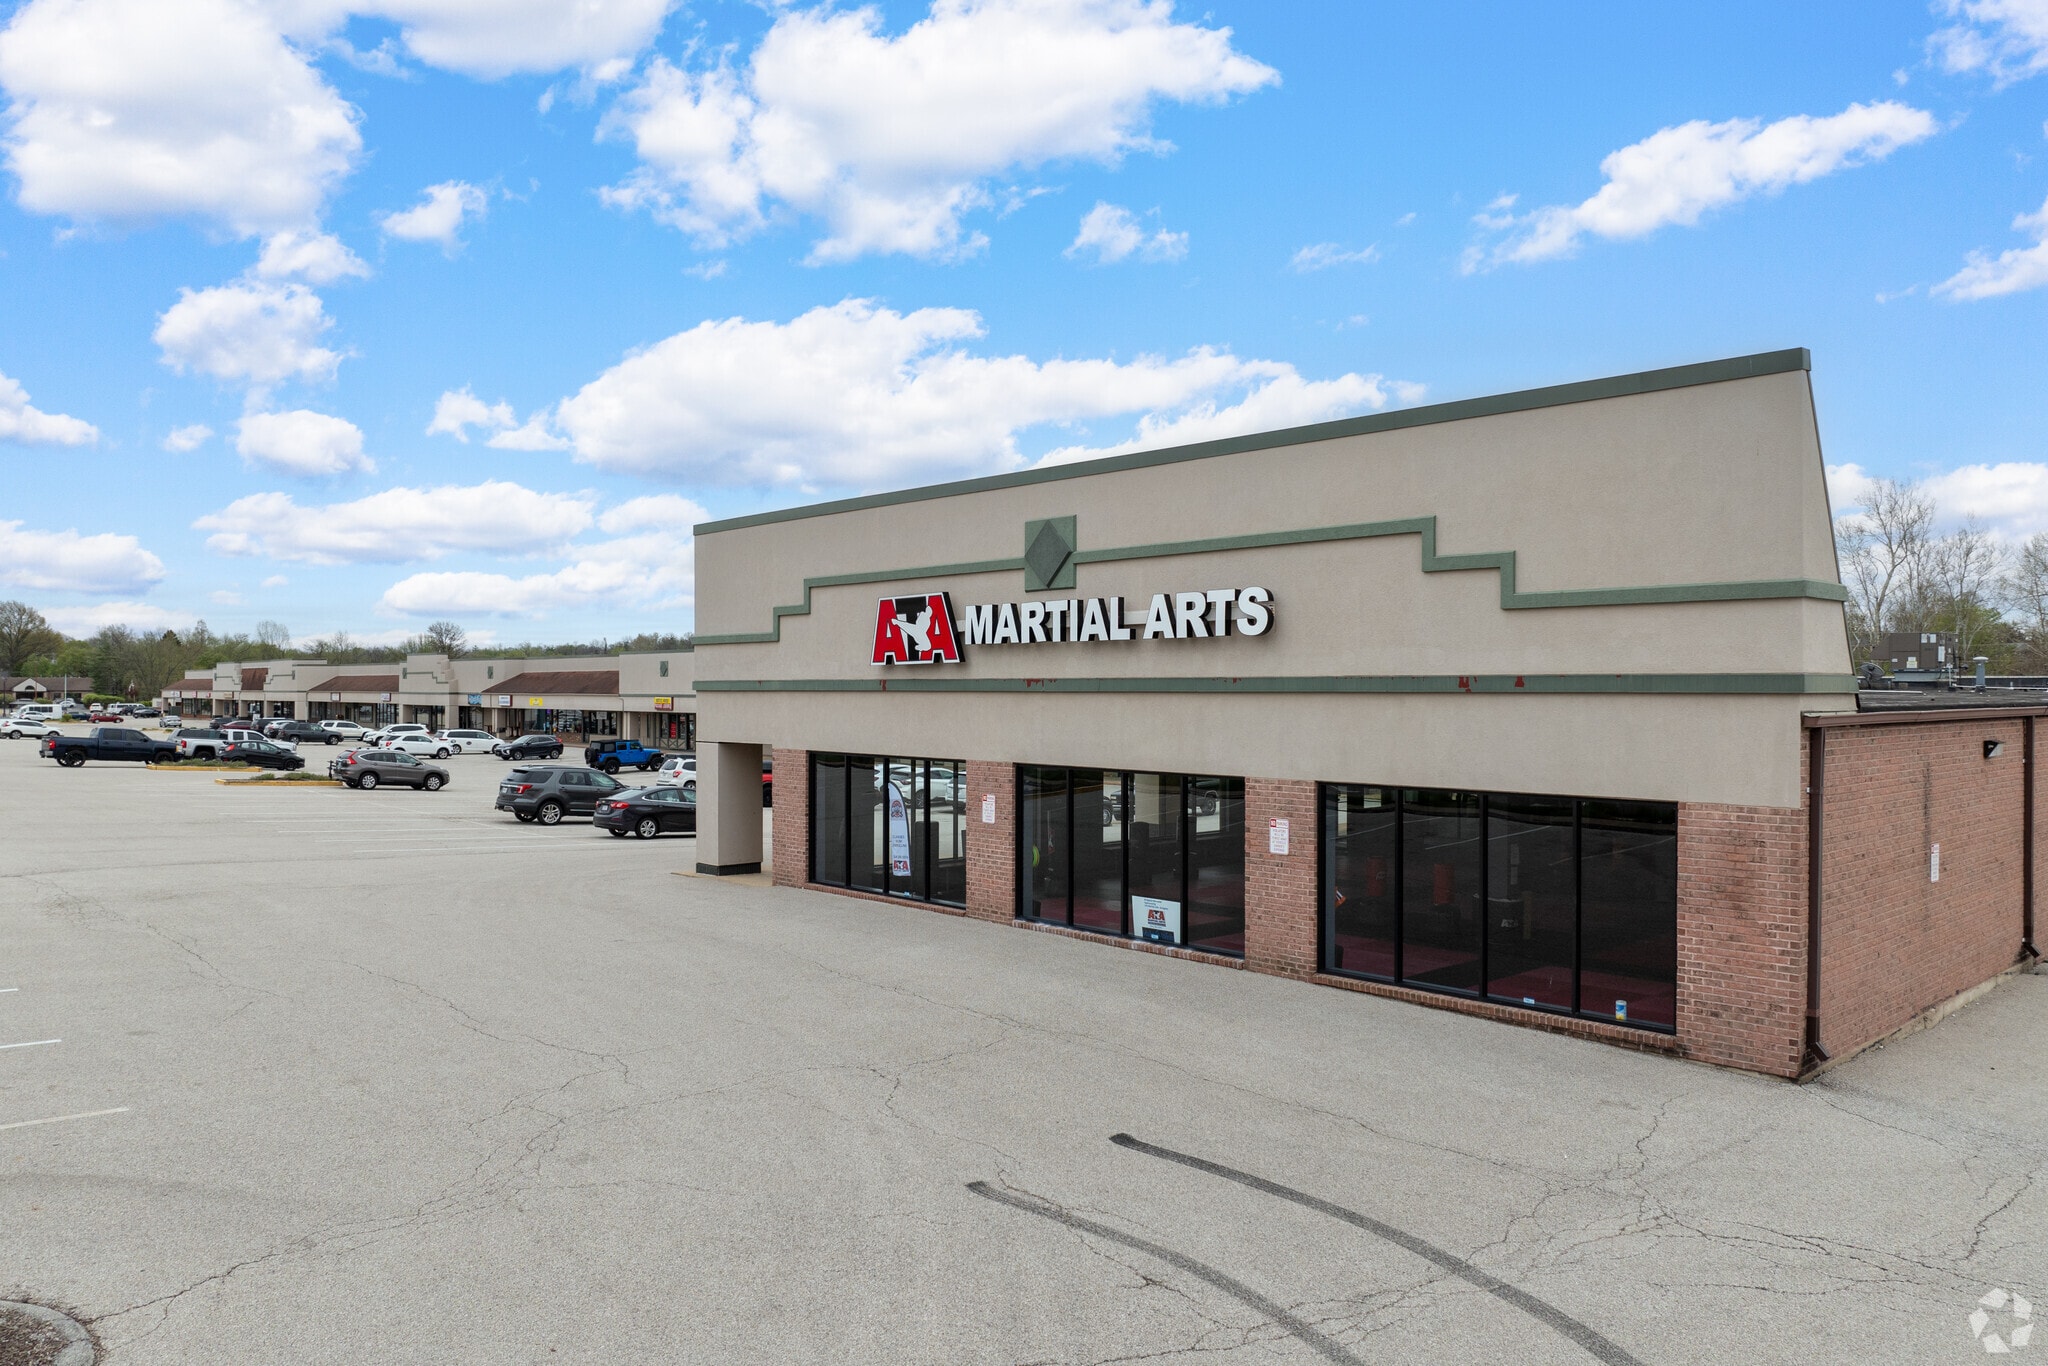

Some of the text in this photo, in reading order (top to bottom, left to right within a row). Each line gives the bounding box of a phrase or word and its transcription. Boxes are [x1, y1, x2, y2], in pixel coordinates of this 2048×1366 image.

[871, 586, 1270, 666] ATA MARTIAL ARTS
